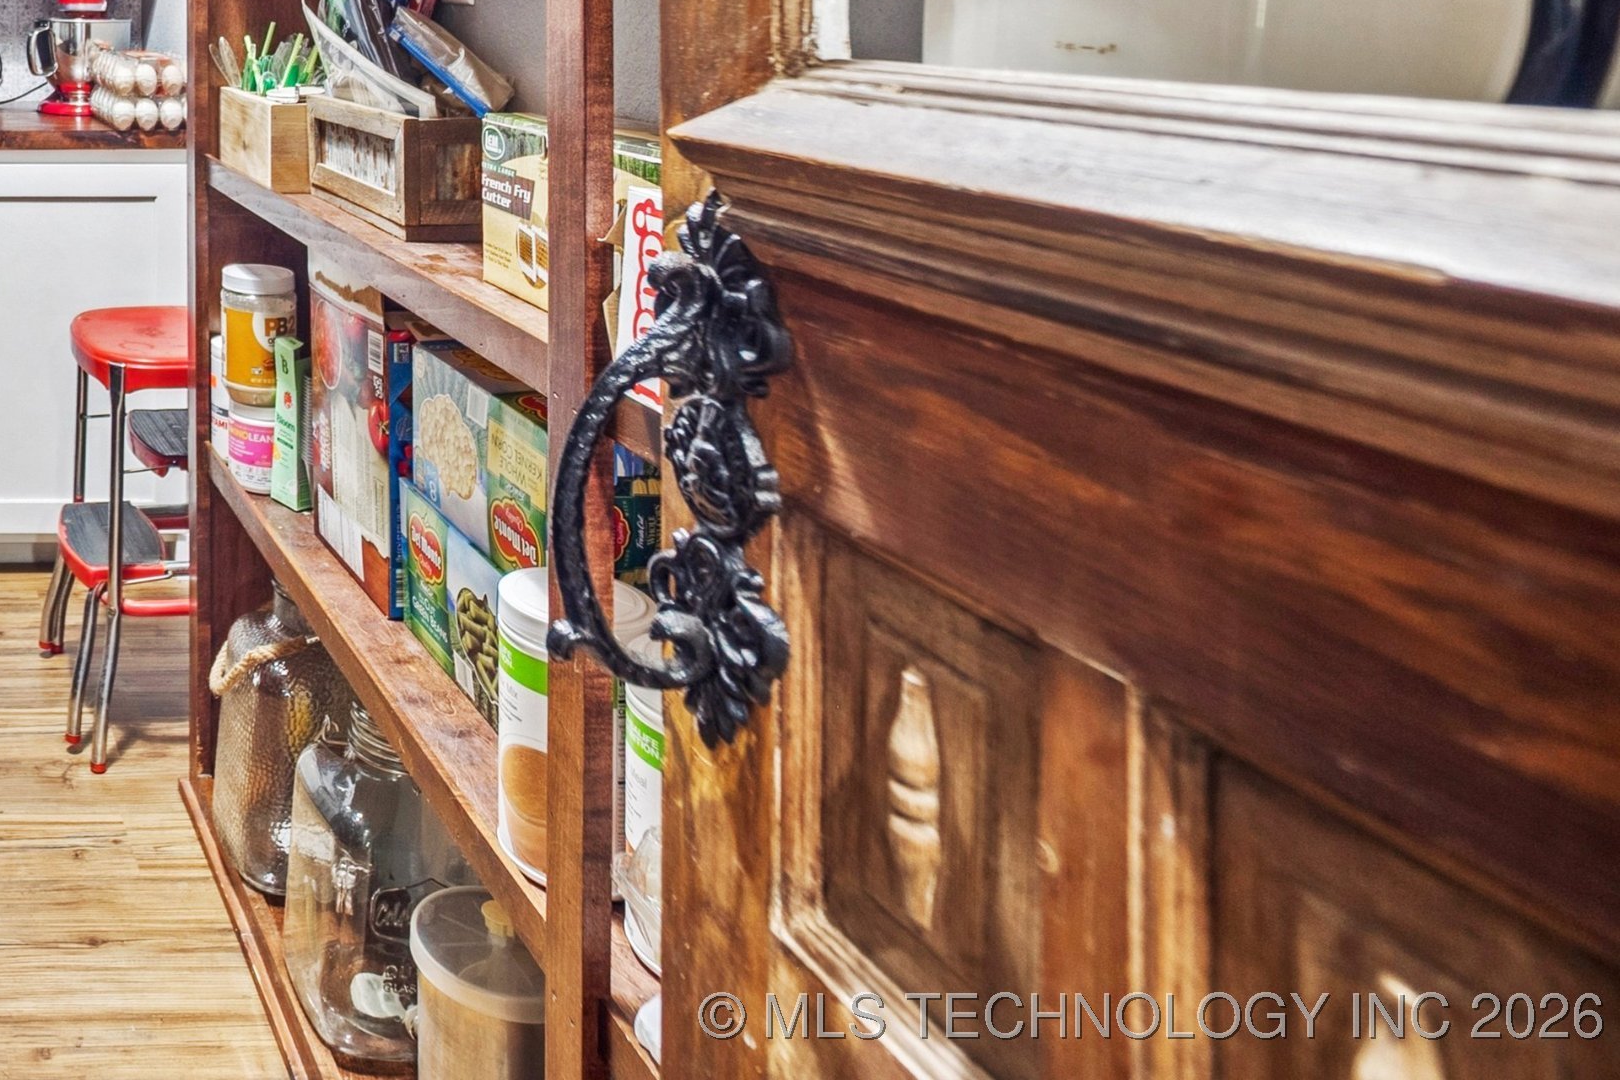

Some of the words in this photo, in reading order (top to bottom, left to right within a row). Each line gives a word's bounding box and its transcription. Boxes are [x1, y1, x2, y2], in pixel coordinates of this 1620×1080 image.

[482, 174, 512, 194] French
[514, 184, 532, 203] Fry
[482, 187, 512, 208] Cutter
[494, 515, 522, 552] Monte
[522, 537, 537, 566] Del
